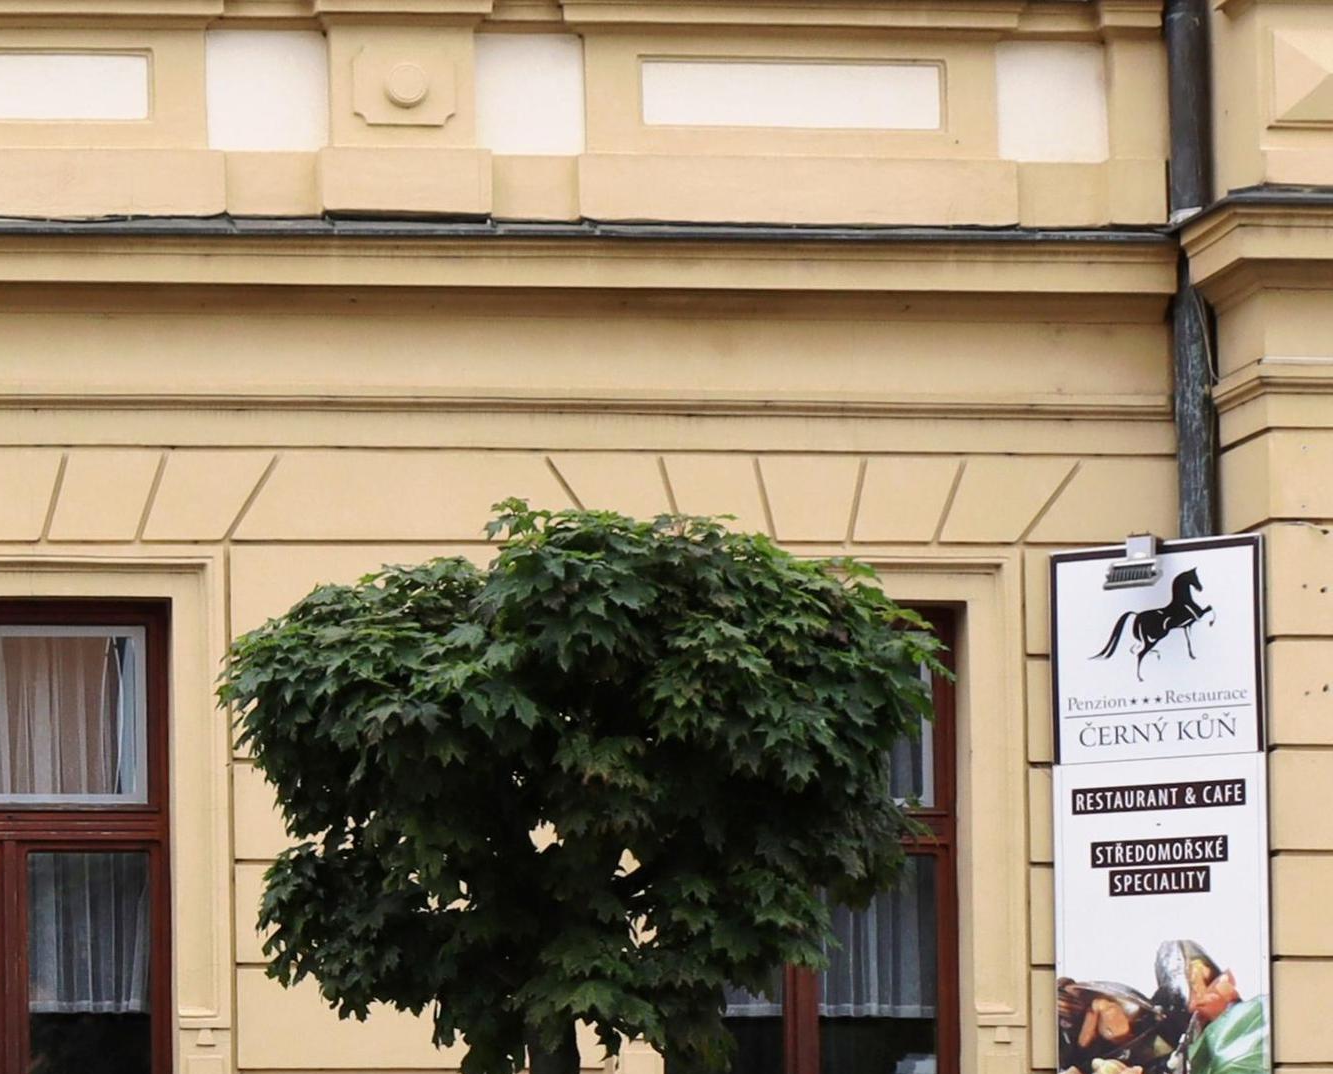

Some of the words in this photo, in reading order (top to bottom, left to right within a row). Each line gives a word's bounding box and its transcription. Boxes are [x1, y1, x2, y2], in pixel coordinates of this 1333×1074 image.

[1067, 695, 1127, 712] Penzion
[1165, 687, 1249, 705] Restaurace
[1079, 716, 1168, 748] ČERNÝ
[1177, 712, 1238, 741] KŮŇ
[1075, 786, 1178, 812] RESTAURANT
[1185, 786, 1197, 805] &
[1203, 782, 1243, 803] CAFE
[1095, 837, 1224, 865] STŘEDOMOŘSKÉ
[1113, 870, 1207, 892] SPECIALITY
